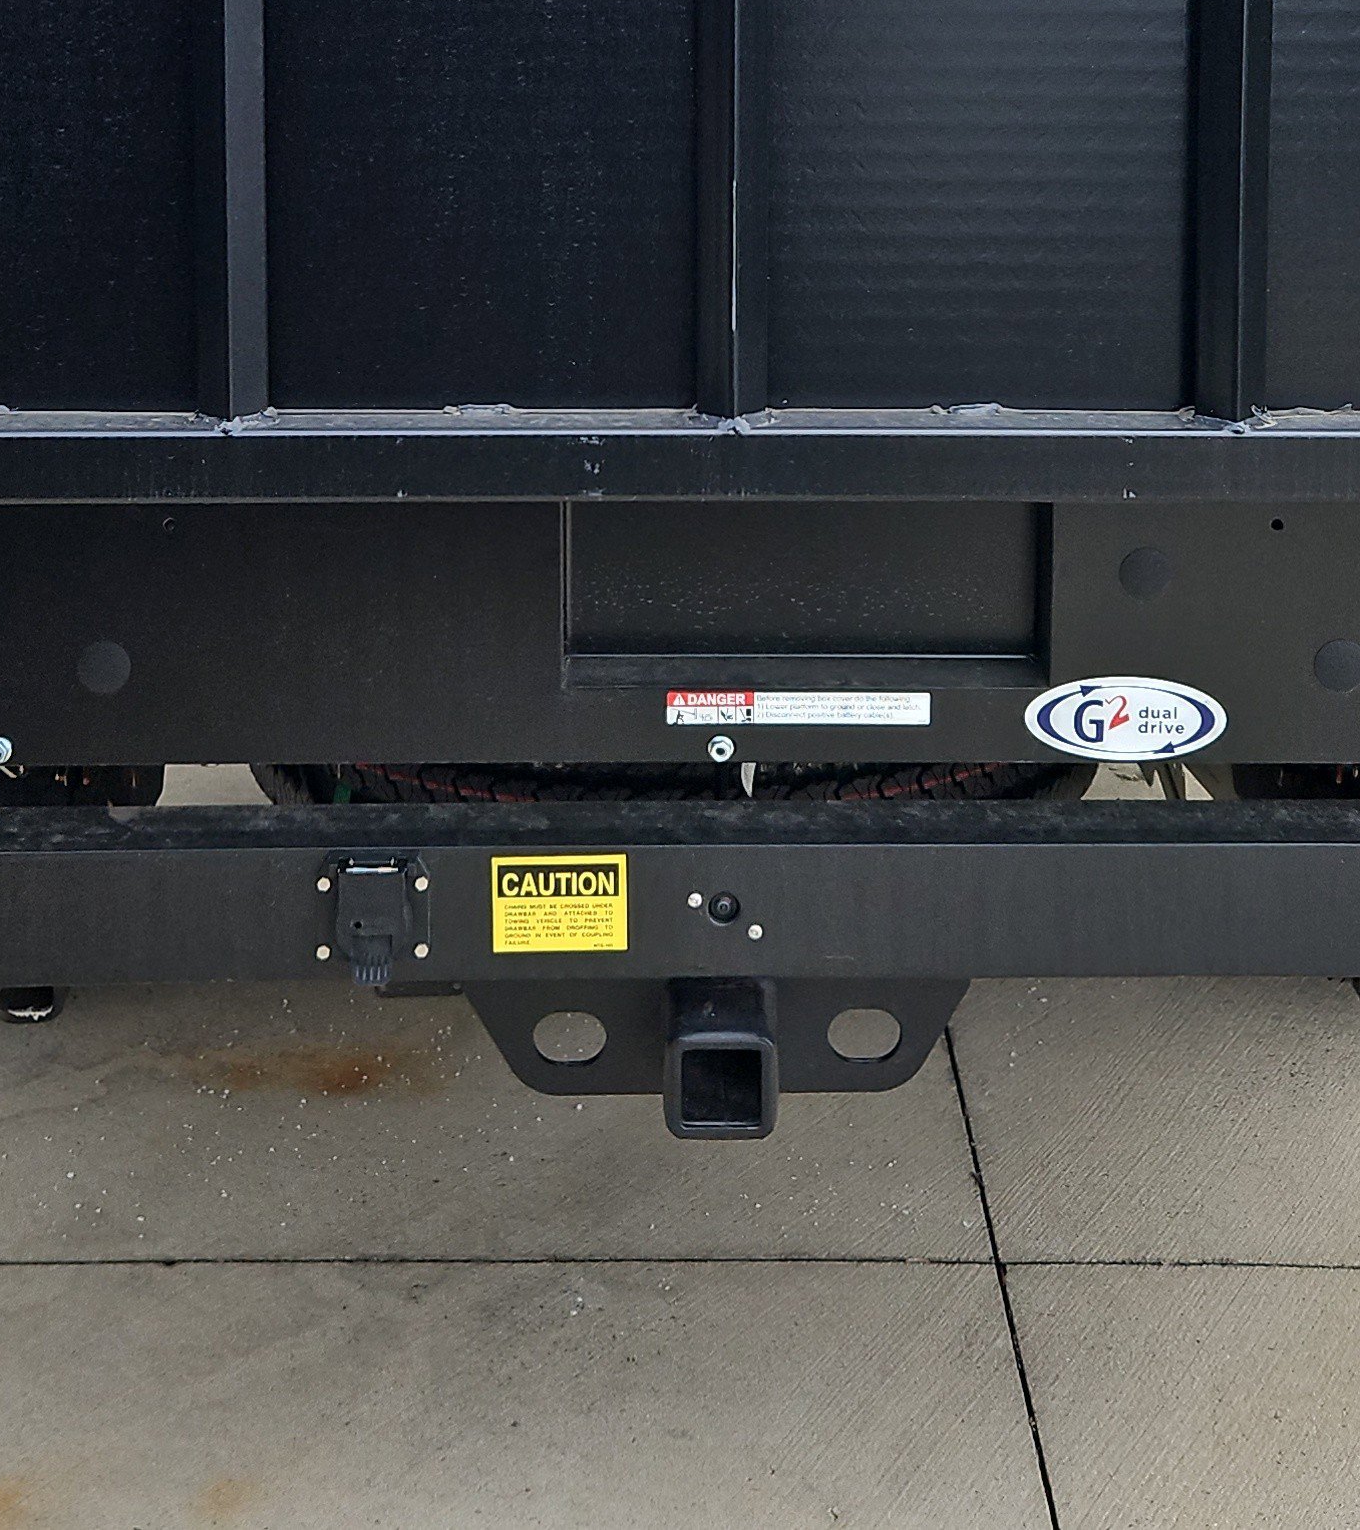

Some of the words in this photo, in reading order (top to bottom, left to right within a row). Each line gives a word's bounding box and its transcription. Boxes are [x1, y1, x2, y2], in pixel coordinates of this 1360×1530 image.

[687, 693, 746, 706] DANGER
[1139, 707, 1177, 719] dual
[1138, 721, 1185, 734] drive
[502, 871, 615, 896] CAUTION
